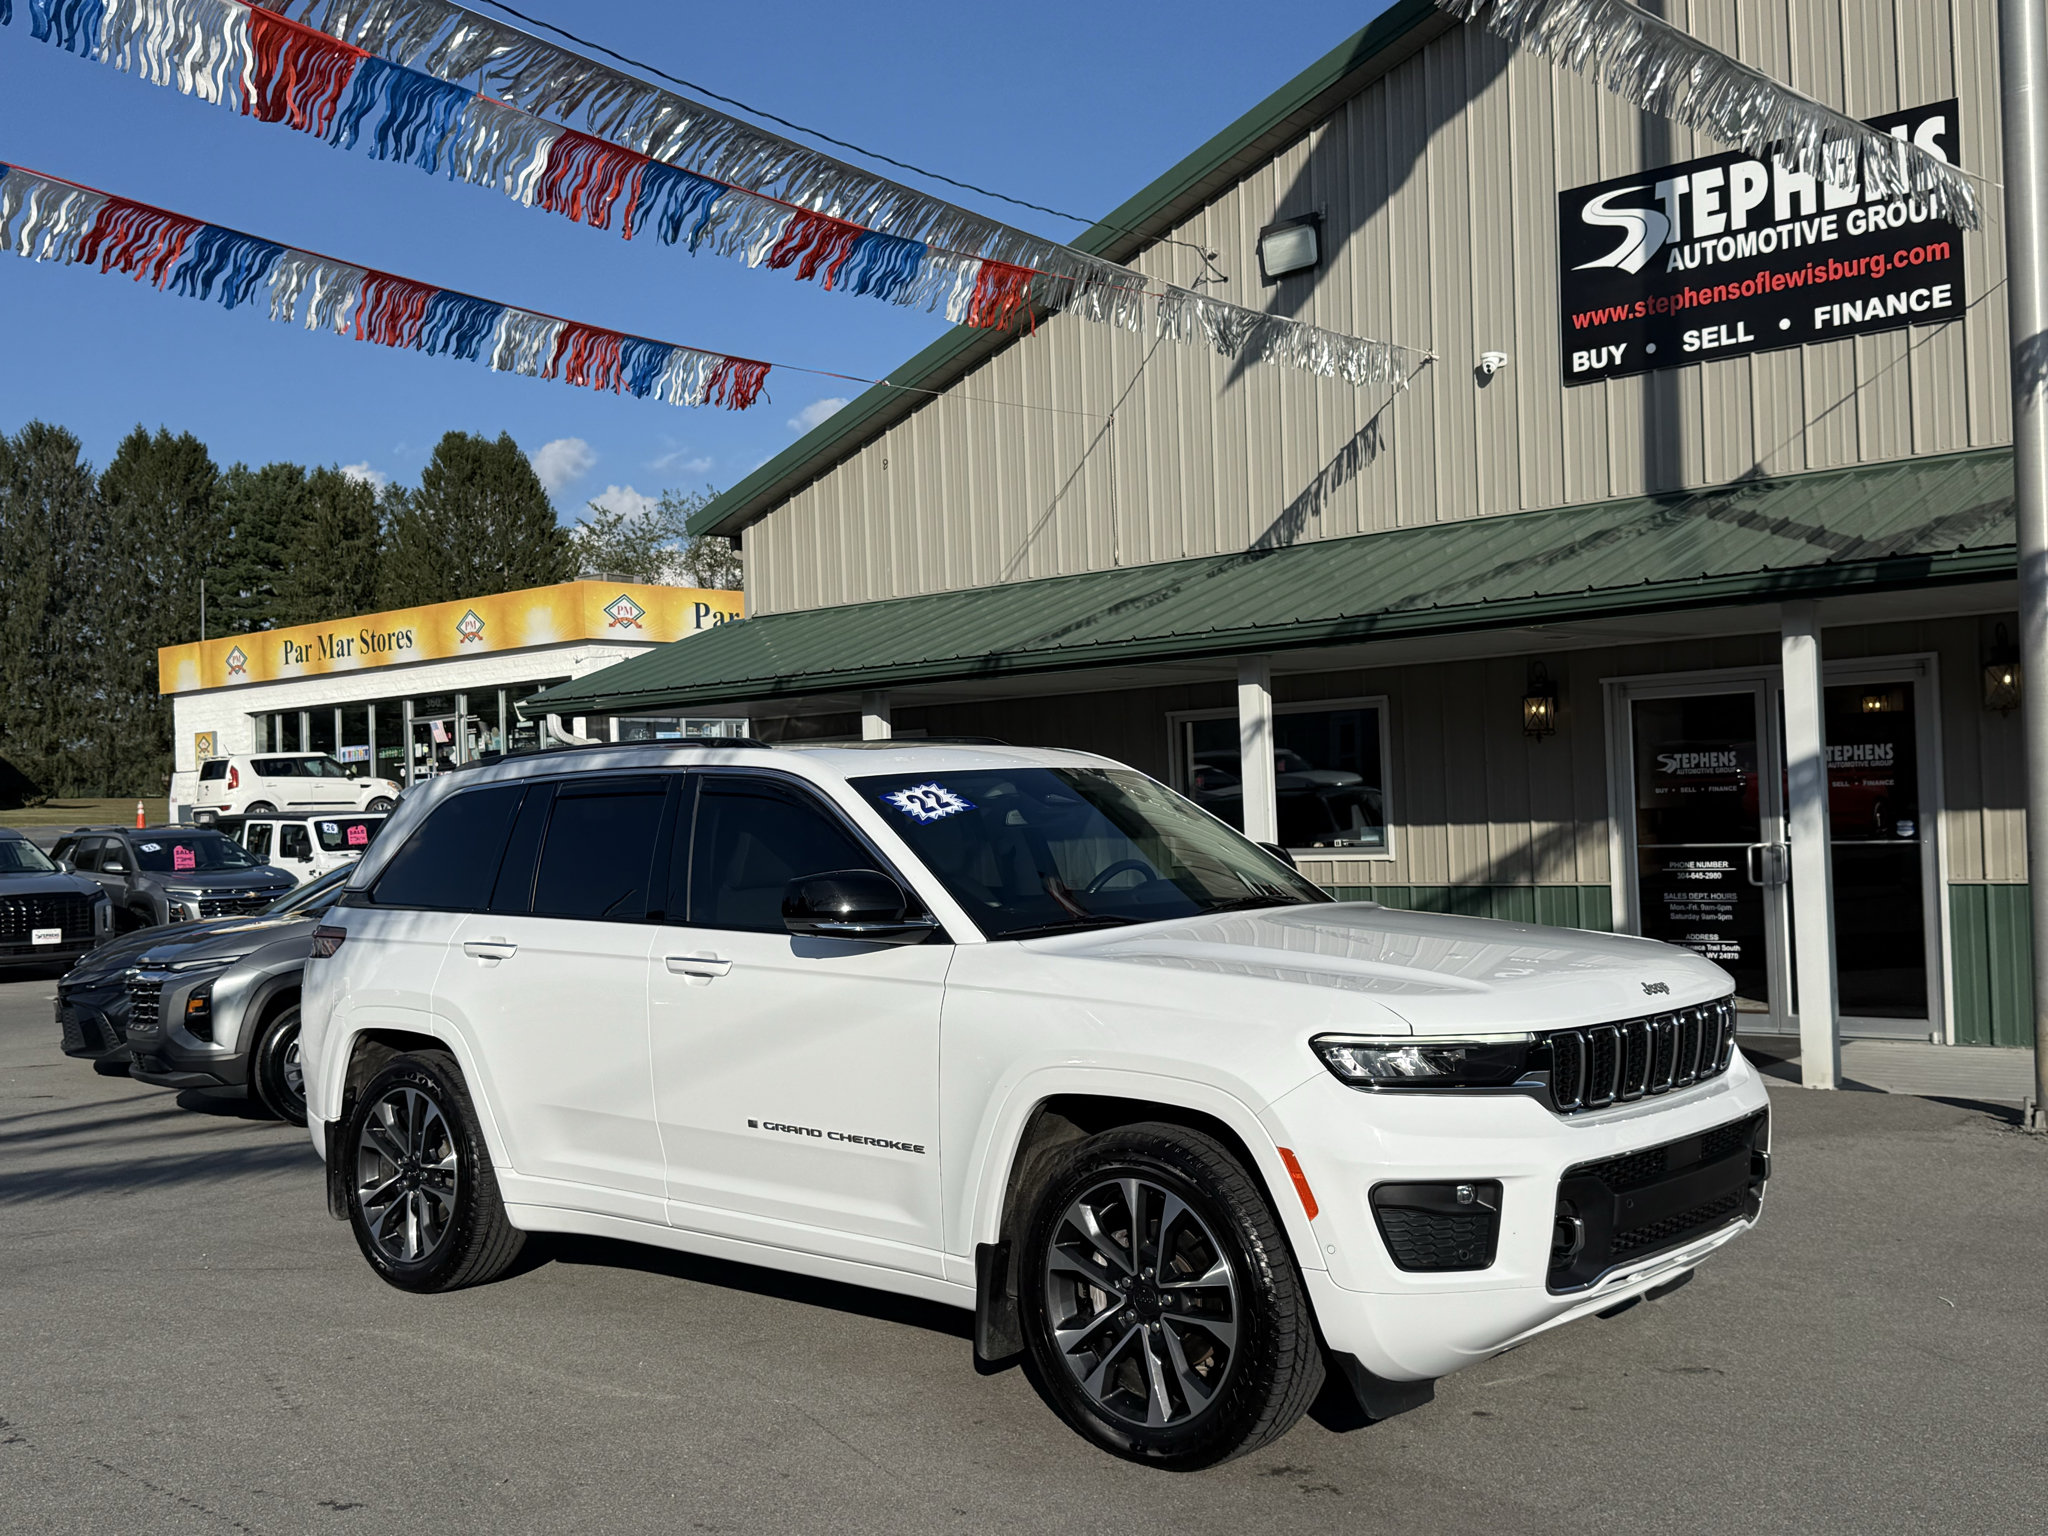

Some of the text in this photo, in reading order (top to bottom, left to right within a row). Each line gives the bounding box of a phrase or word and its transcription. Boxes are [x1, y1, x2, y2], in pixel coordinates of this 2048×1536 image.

[1666, 213, 1838, 274] AUTOMOTIVE
[1572, 240, 1950, 329] www.stephensoflewisburg.com
[1572, 283, 1952, 373] BUY SELL FINANCE
[617, 605, 633, 616] PM
[692, 602, 740, 629] Par
[284, 627, 413, 665] Par Mar Stores
[1826, 743, 1894, 762] TEPHENS
[1656, 751, 1737, 774] STEPHENS
[1676, 767, 1714, 775] AUTOMOTIVE
[906, 790, 955, 814] 22
[1696, 860, 1729, 868] NUMBER
[1664, 892, 1738, 900] SALES DEPT. HOURS
[1670, 913, 1700, 921] Saturday
[1686, 933, 1720, 941] ADDRESS
[1706, 943, 1720, 951] Trail
[1721, 944, 1741, 952] South
[1641, 981, 1670, 996] Jeep
[763, 1121, 926, 1154] GRAND CHEROKEE
